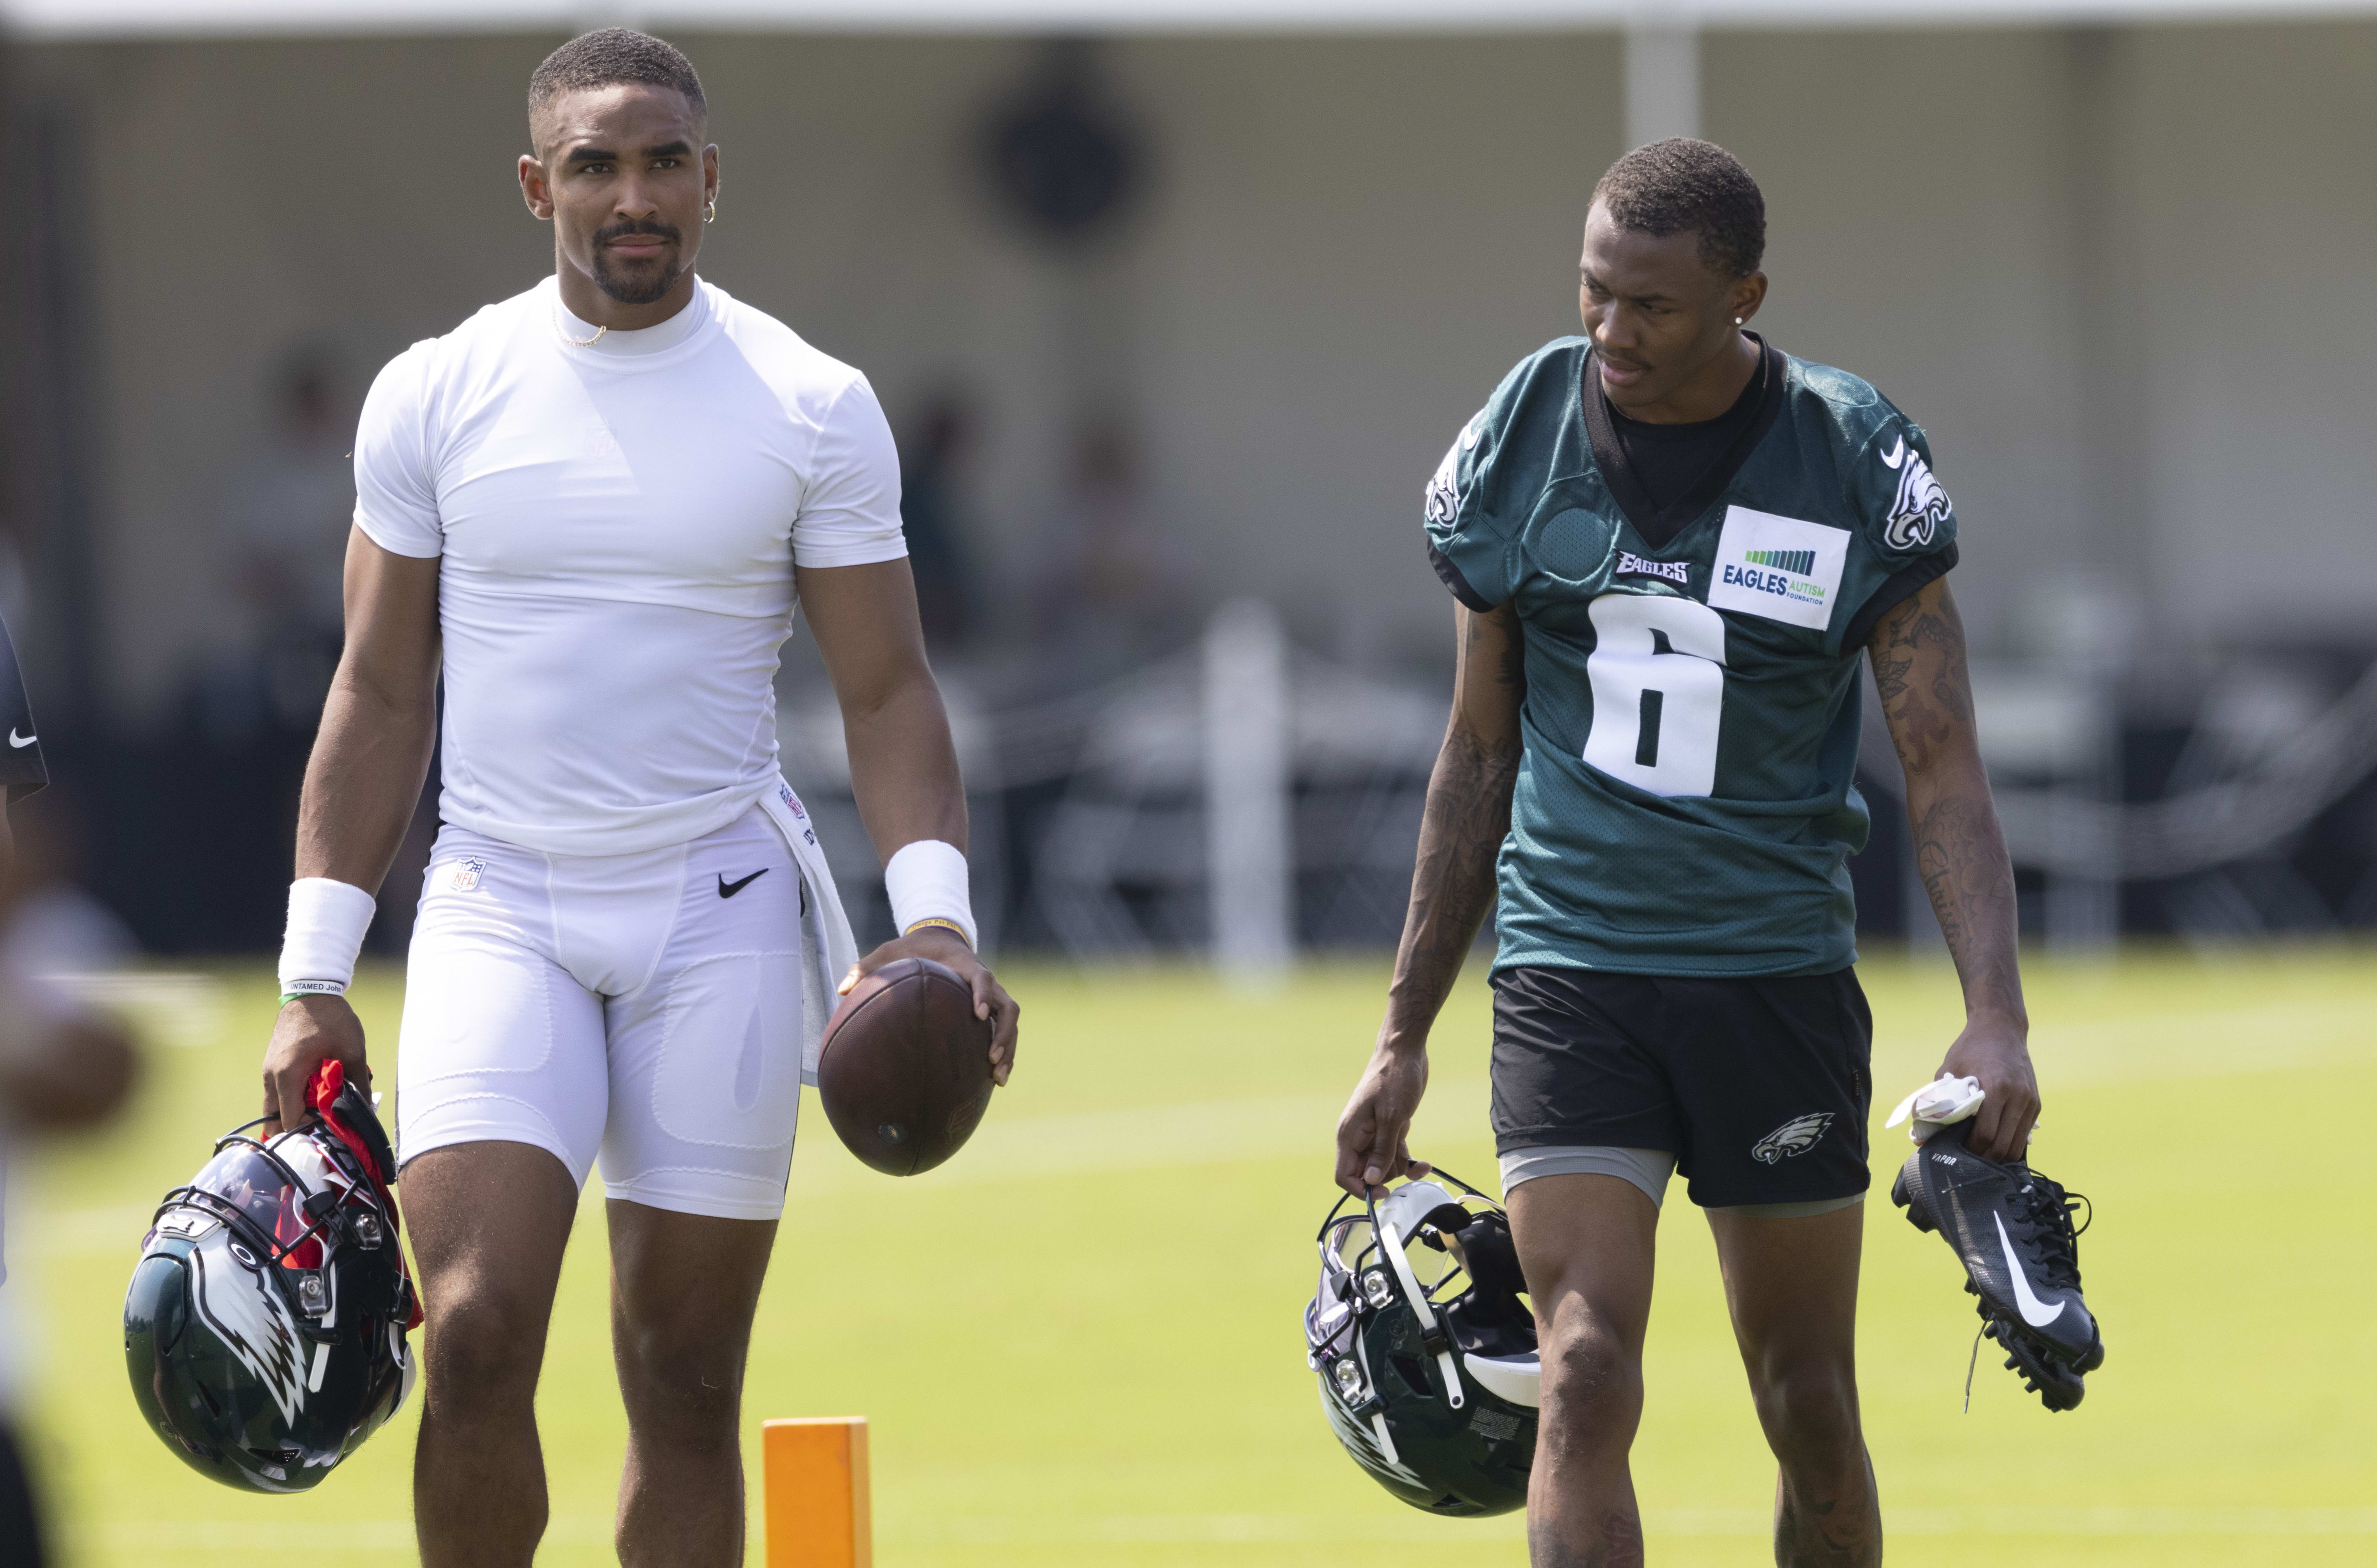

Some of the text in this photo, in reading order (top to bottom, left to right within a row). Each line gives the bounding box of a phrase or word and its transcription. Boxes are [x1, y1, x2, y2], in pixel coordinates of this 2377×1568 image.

[1615, 551, 1691, 583] EAGLES
[1723, 564, 1826, 598] EAGLES AUTISM
[1787, 592, 1823, 605] FOUNDATION
[1583, 594, 1728, 797] 6
[454, 872, 474, 885] NFL
[912, 920, 931, 929] Omega
[326, 984, 342, 993] John
[1931, 1153, 1957, 1166] VAPOR
